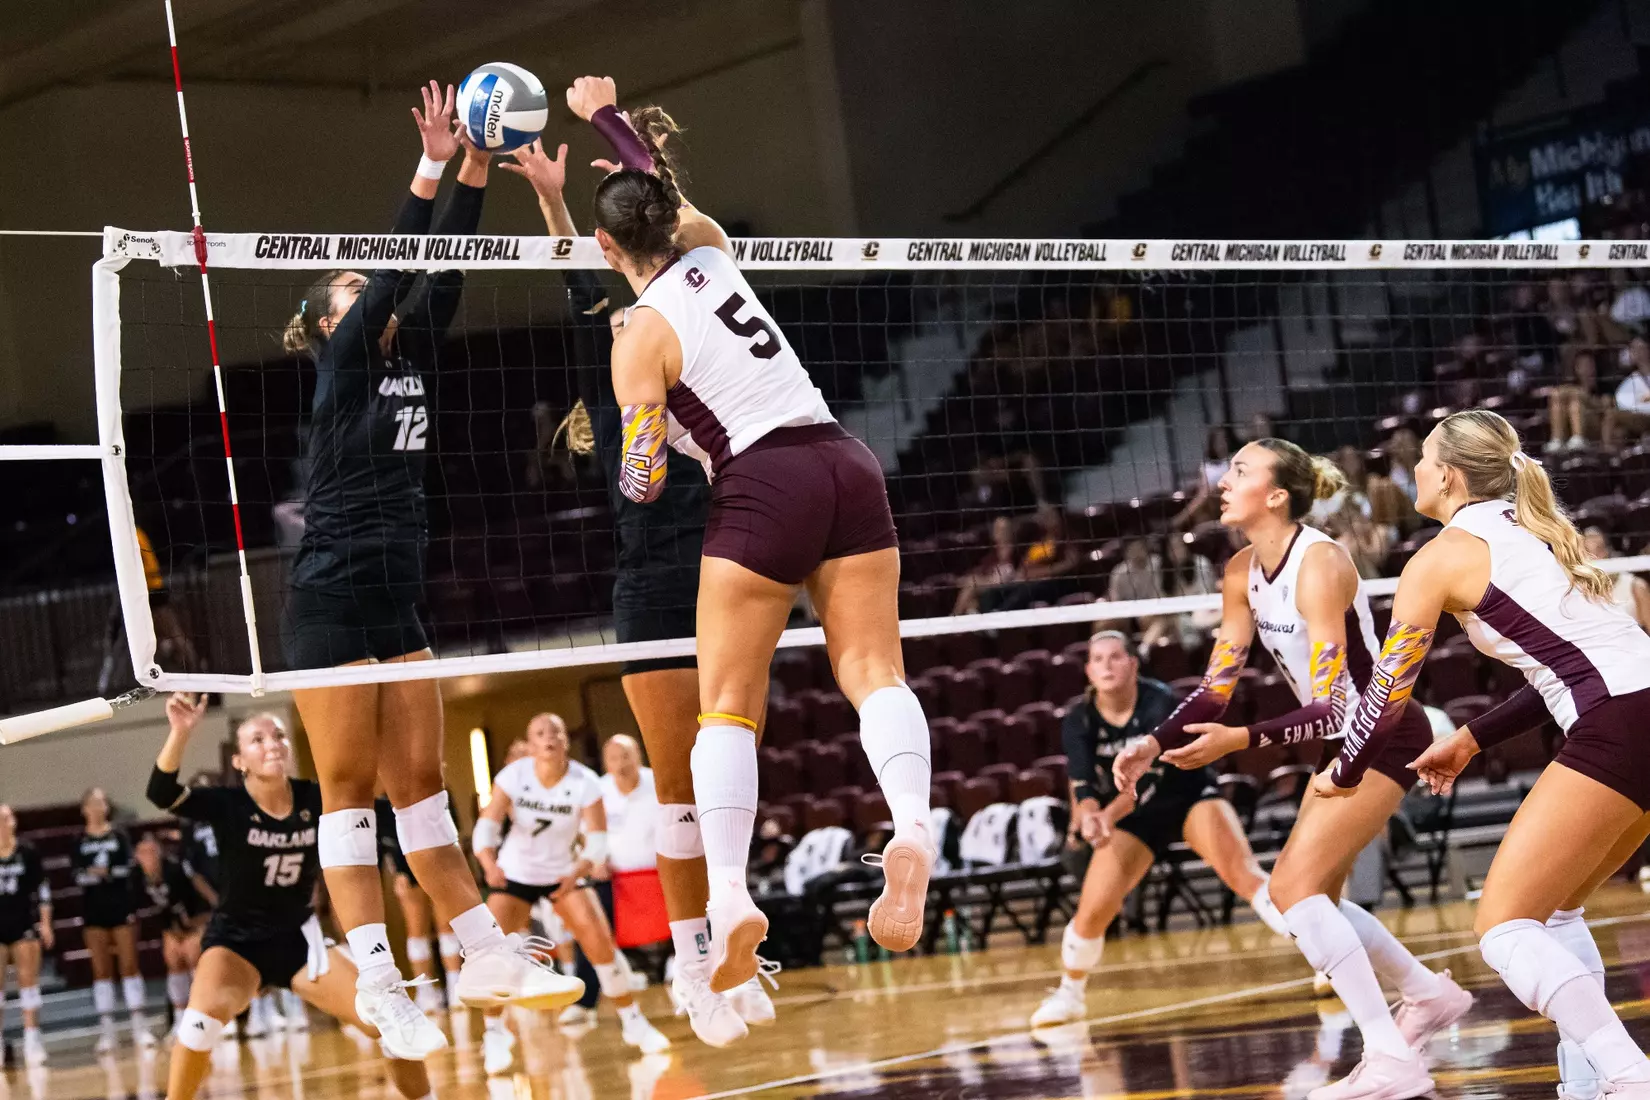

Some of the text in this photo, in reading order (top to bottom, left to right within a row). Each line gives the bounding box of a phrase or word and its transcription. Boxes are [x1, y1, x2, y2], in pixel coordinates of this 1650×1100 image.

[486, 90, 504, 139] molten
[255, 235, 520, 260] CENTRAL MICHIGAN VOLLEYBALL
[750, 241, 833, 261] VOLLEYBALL
[907, 242, 1107, 261] CENTRAL MICHIGAN VOLLEYBALL
[1171, 244, 1346, 261] CENTRAL MICHIGAN VOLLEYBALL
[714, 292, 782, 360] 5
[393, 406, 428, 450] 12
[532, 818, 552, 838] 7
[264, 852, 305, 888] 15
